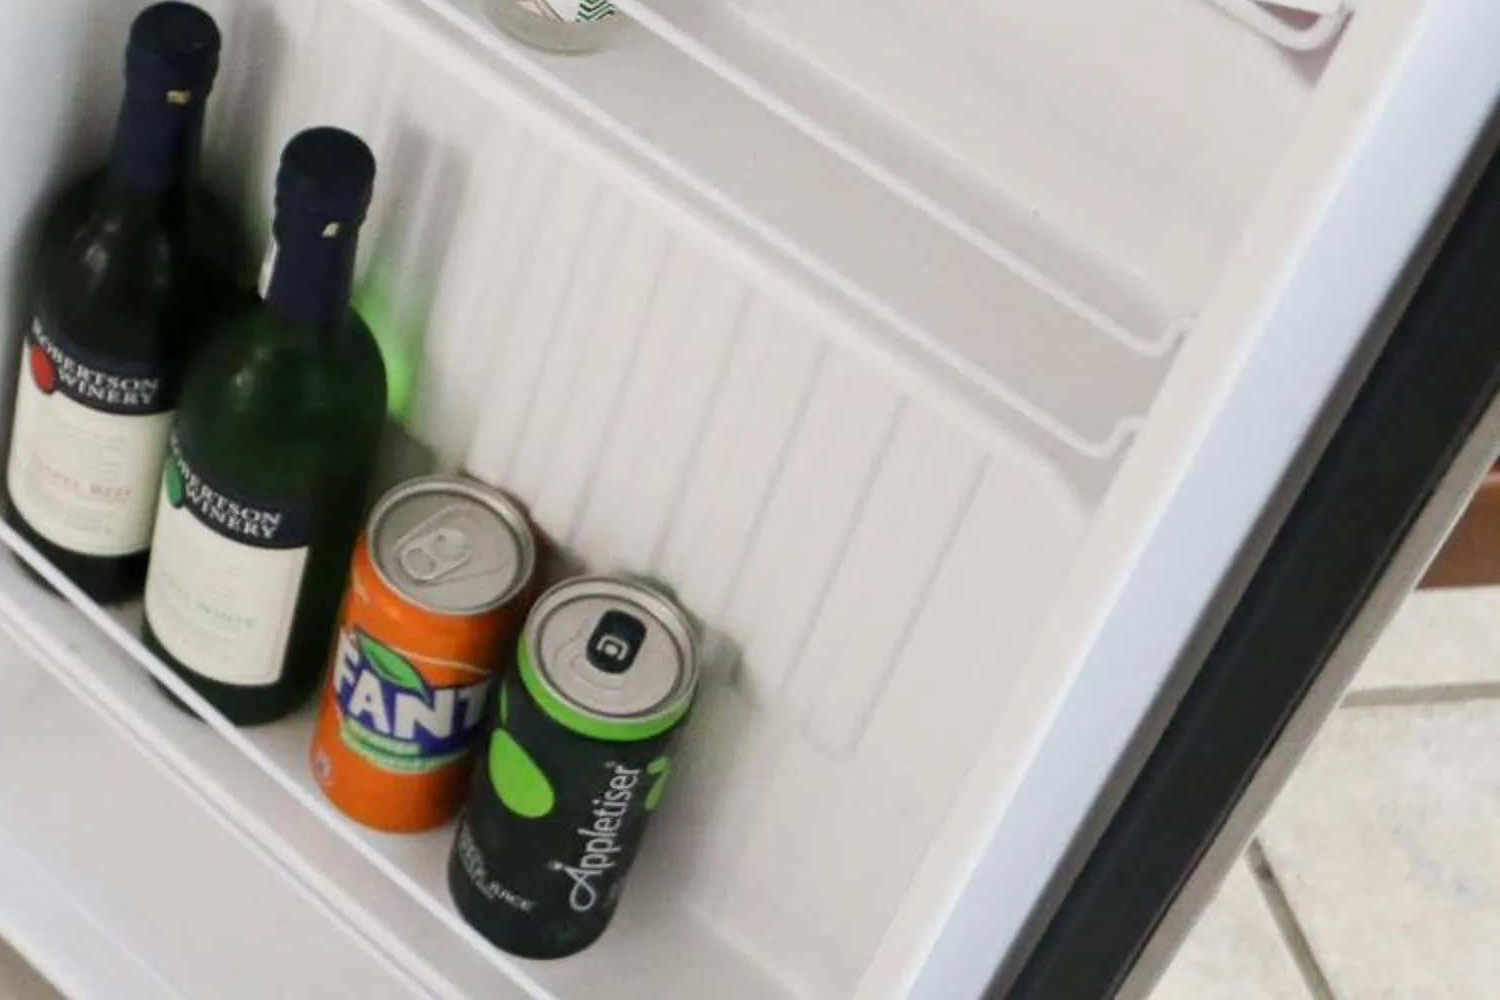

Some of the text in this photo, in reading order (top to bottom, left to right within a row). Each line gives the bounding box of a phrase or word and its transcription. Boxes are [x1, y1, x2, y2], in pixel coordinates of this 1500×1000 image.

[31, 317, 160, 391] ROBERTSON
[57, 370, 158, 406] WINERY
[185, 483, 279, 540] WINERY
[552, 760, 641, 912] Appletiser
